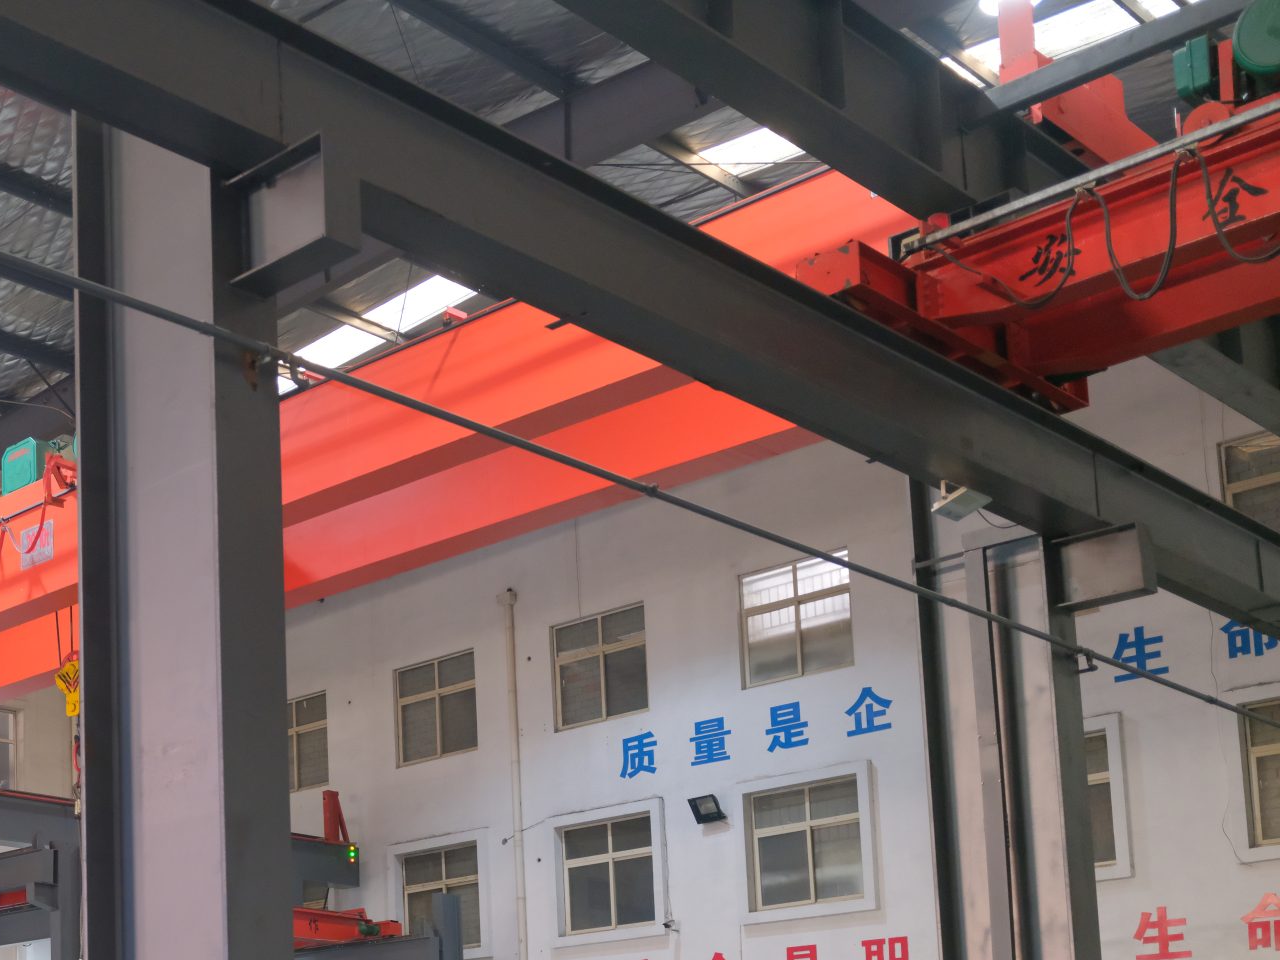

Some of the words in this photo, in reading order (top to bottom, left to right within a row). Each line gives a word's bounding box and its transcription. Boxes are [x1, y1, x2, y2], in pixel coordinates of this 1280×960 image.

[619, 686, 893, 779] 质量是企
[1112, 619, 1280, 683] 生命
